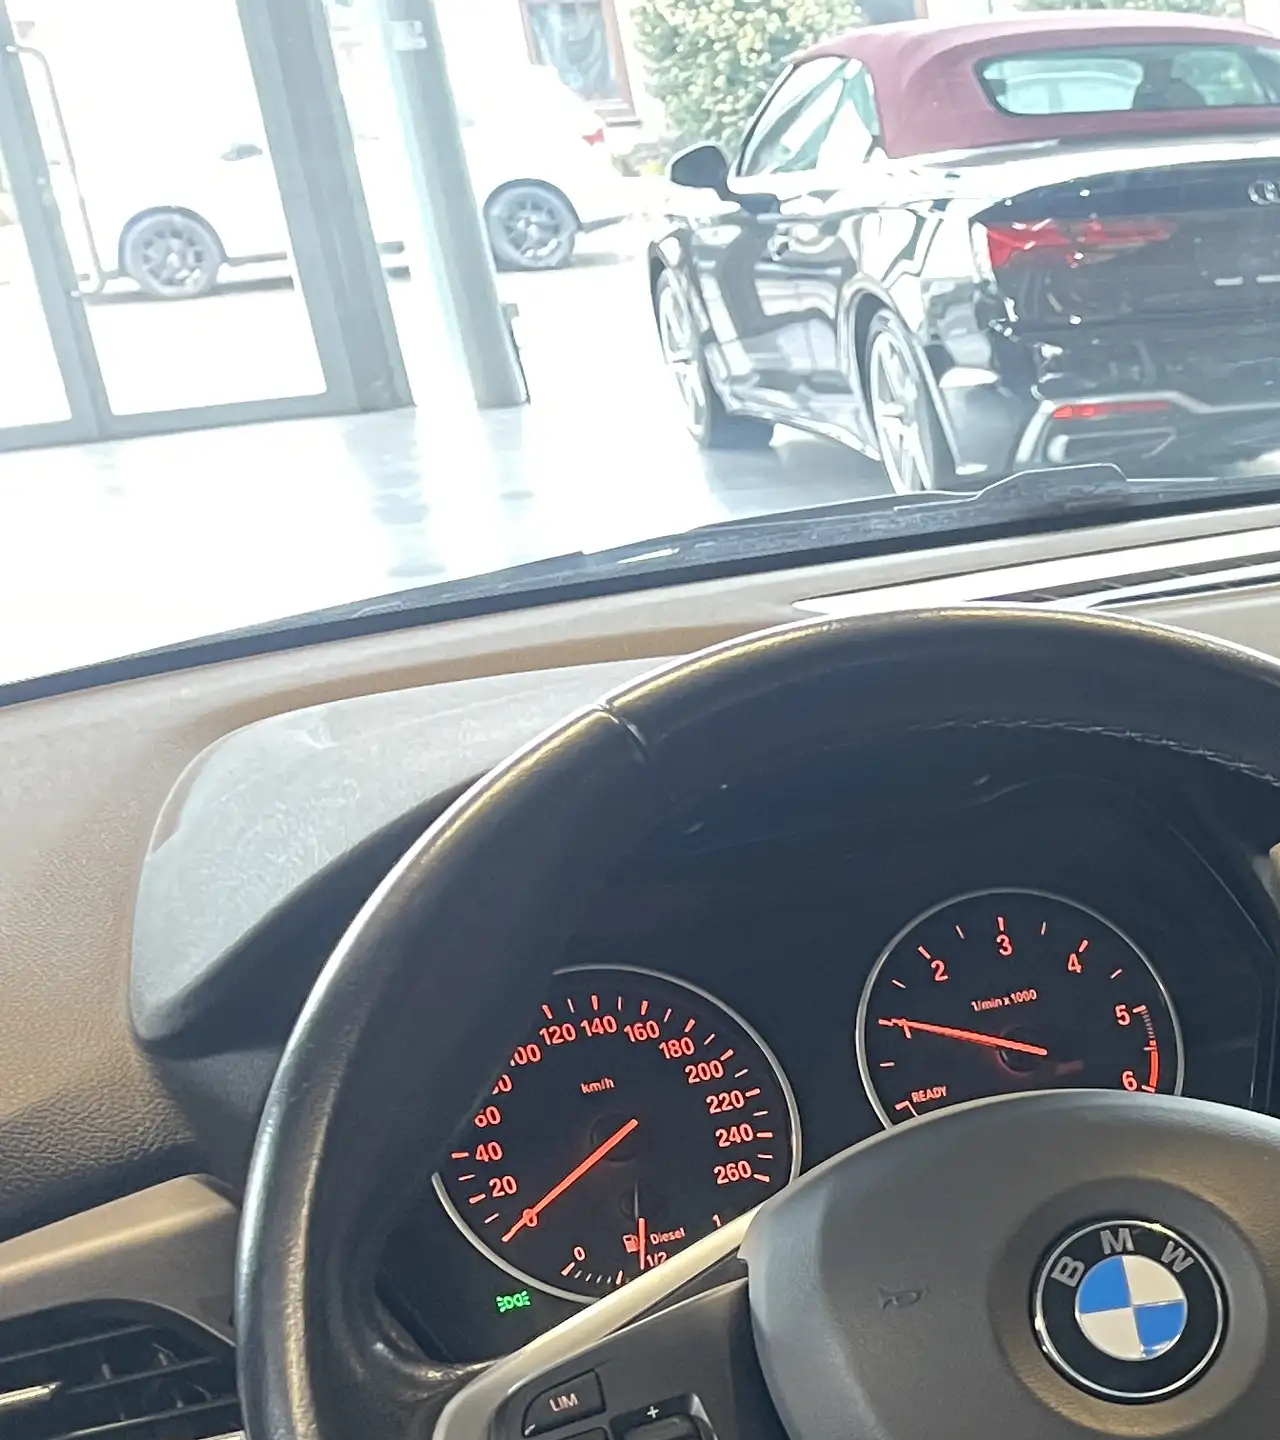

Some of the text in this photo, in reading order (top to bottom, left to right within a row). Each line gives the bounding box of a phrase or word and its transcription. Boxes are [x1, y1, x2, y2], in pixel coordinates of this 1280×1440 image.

[996, 934, 1012, 956] 3
[931, 959, 948, 982] 2
[1067, 953, 1083, 974] 4
[1010, 988, 1037, 1003] 1000
[580, 1015, 618, 1037] 140
[1115, 1004, 1131, 1026] 5
[539, 1023, 577, 1045] 120
[624, 1020, 660, 1043] 160
[510, 1044, 541, 1067] 00
[658, 1036, 696, 1059] 180
[684, 1059, 724, 1084] 200
[1121, 1070, 1138, 1092] 6
[580, 1077, 616, 1094] km/h
[910, 1085, 948, 1103] READY
[705, 1089, 745, 1114] 220
[715, 1123, 754, 1148] 240
[475, 1141, 504, 1163] 40
[713, 1160, 752, 1185] 260
[488, 1175, 517, 1197] 20
[649, 1227, 686, 1245] Diesel
[573, 1246, 586, 1261] 0
[1051, 1228, 1195, 1287] BMW
[548, 1393, 579, 1413] LIM
